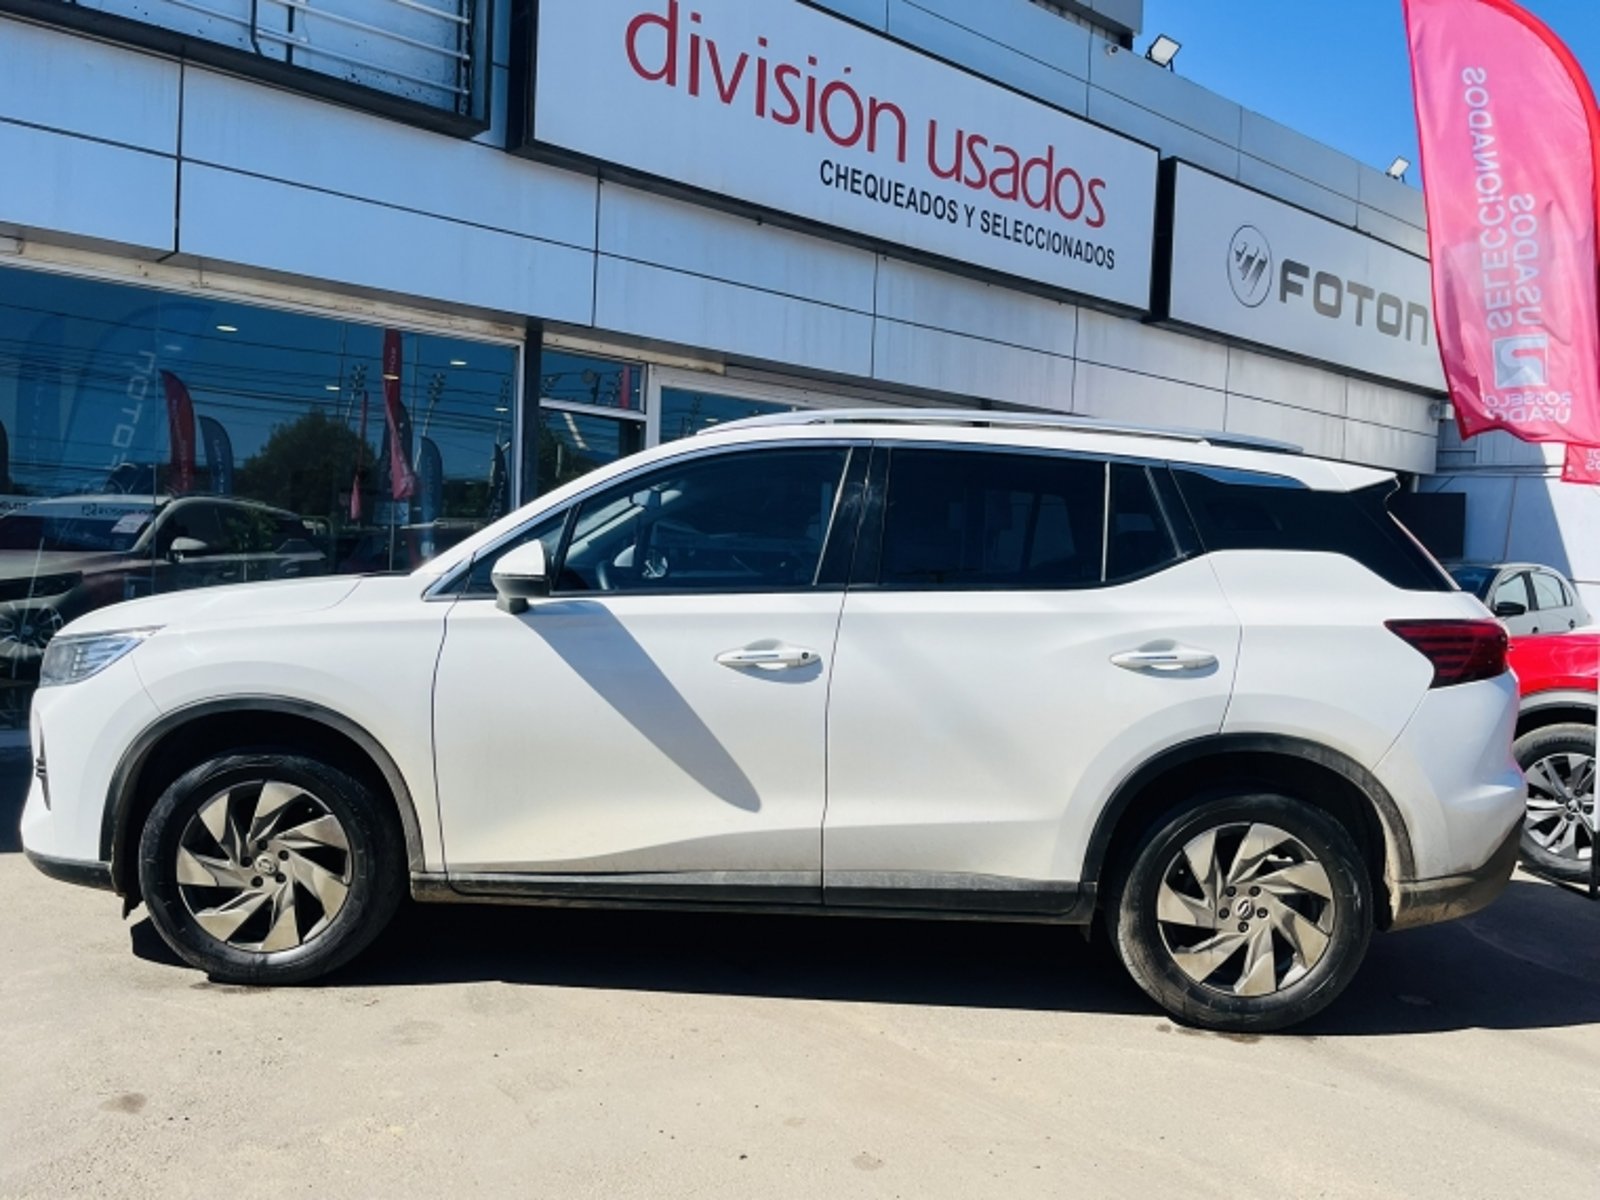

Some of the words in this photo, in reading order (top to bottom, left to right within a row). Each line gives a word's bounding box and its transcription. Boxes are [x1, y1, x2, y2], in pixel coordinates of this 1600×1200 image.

[625, 0, 906, 162] división
[927, 118, 1106, 229] usados
[820, 159, 959, 224] CHEQUEADOS
[964, 204, 976, 228] Y
[980, 210, 1116, 270] SELECCIONADOS
[1279, 258, 1429, 346] FOTON
